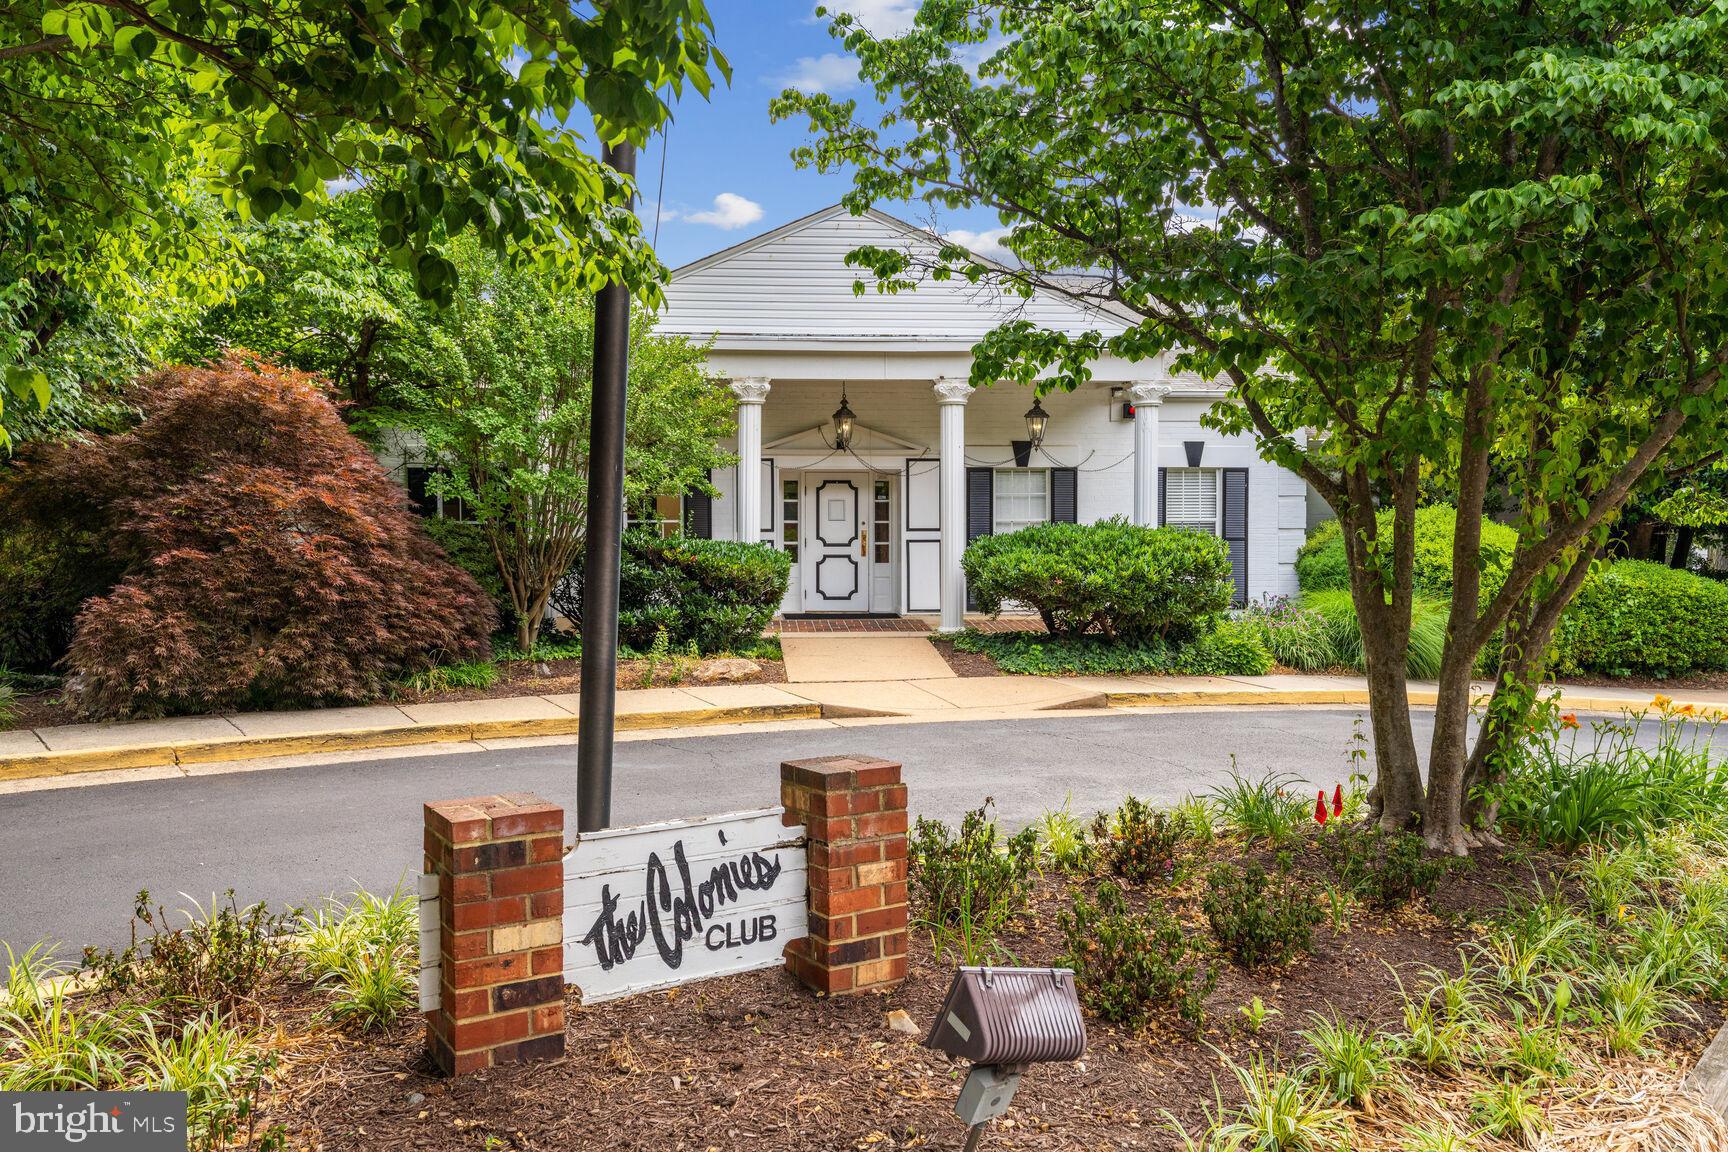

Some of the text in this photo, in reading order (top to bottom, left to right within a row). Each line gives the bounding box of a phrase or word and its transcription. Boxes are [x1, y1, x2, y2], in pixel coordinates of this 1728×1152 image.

[582, 829, 782, 971] the Colonies
[705, 914, 778, 952] CLUB
